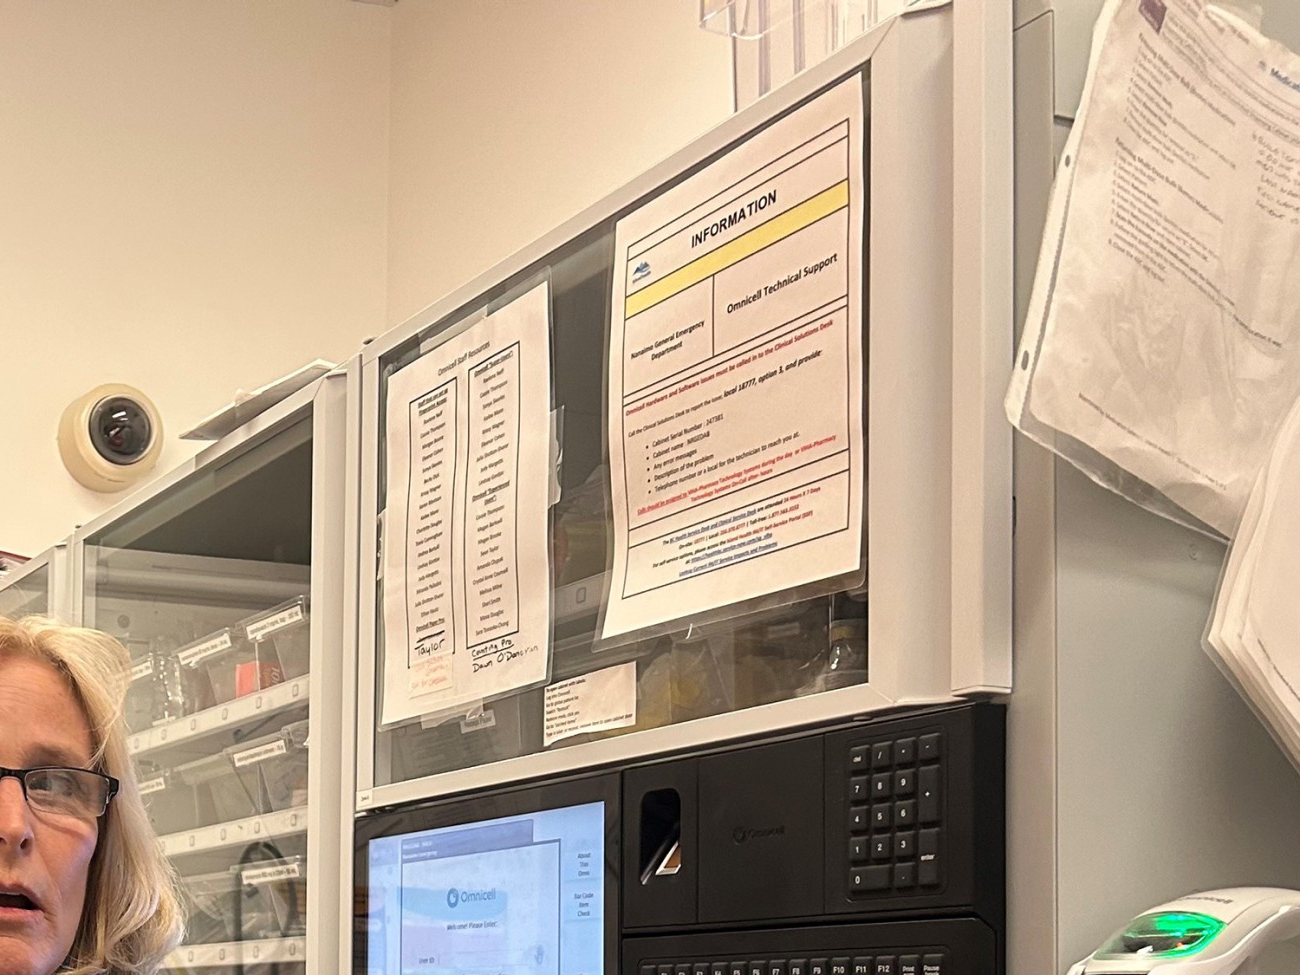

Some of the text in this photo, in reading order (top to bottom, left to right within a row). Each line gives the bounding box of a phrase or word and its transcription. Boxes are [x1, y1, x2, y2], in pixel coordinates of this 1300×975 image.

[690, 189, 777, 249] INFORMATION
[726, 253, 837, 314] Omnicell Technical Support
[630, 319, 704, 360] Nanaimo General Emergency
[457, 352, 467, 365] Staff
[650, 340, 682, 361] Department
[645, 394, 667, 408] Hardware
[668, 389, 677, 397] and
[678, 379, 699, 393] Software
[715, 367, 728, 377] must
[728, 363, 735, 372] be
[735, 357, 751, 368] called
[751, 353, 757, 361] in
[757, 351, 763, 359] to
[764, 347, 773, 355] the
[774, 338, 793, 350] Clinical
[794, 326, 818, 341] Solutions
[819, 319, 833, 330] Desk
[723, 386, 737, 396] local
[757, 369, 777, 384] option
[784, 359, 797, 370] and
[652, 436, 669, 447] Cabinet
[670, 430, 683, 439] Serial
[683, 423, 702, 434] Number
[652, 447, 670, 458] Cabinet
[653, 449, 697, 470] Any error messages
[653, 467, 679, 482] Description
[685, 461, 693, 469] the
[694, 453, 714, 466] problem
[654, 479, 678, 492] Telephone
[678, 473, 696, 482] number
[706, 463, 717, 472] local
[726, 456, 734, 465] the
[735, 447, 760, 461] technician
[760, 444, 767, 452] to
[767, 438, 781, 448] reach
[782, 435, 792, 443] you
[414, 639, 444, 661] Taylor
[500, 636, 512, 647] Pro
[855, 778, 906, 793] 7 8 9
[901, 809, 906, 817] 6
[877, 843, 882, 851] 2
[901, 840, 906, 848] 3
[855, 876, 860, 884] 0
[460, 887, 496, 903] Omnicell
[468, 920, 483, 930] Please
[772, 968, 780, 975] F7
[792, 967, 800, 975] F8
[833, 966, 845, 974] F10
[855, 965, 867, 973] F11
[877, 965, 890, 973] F12
